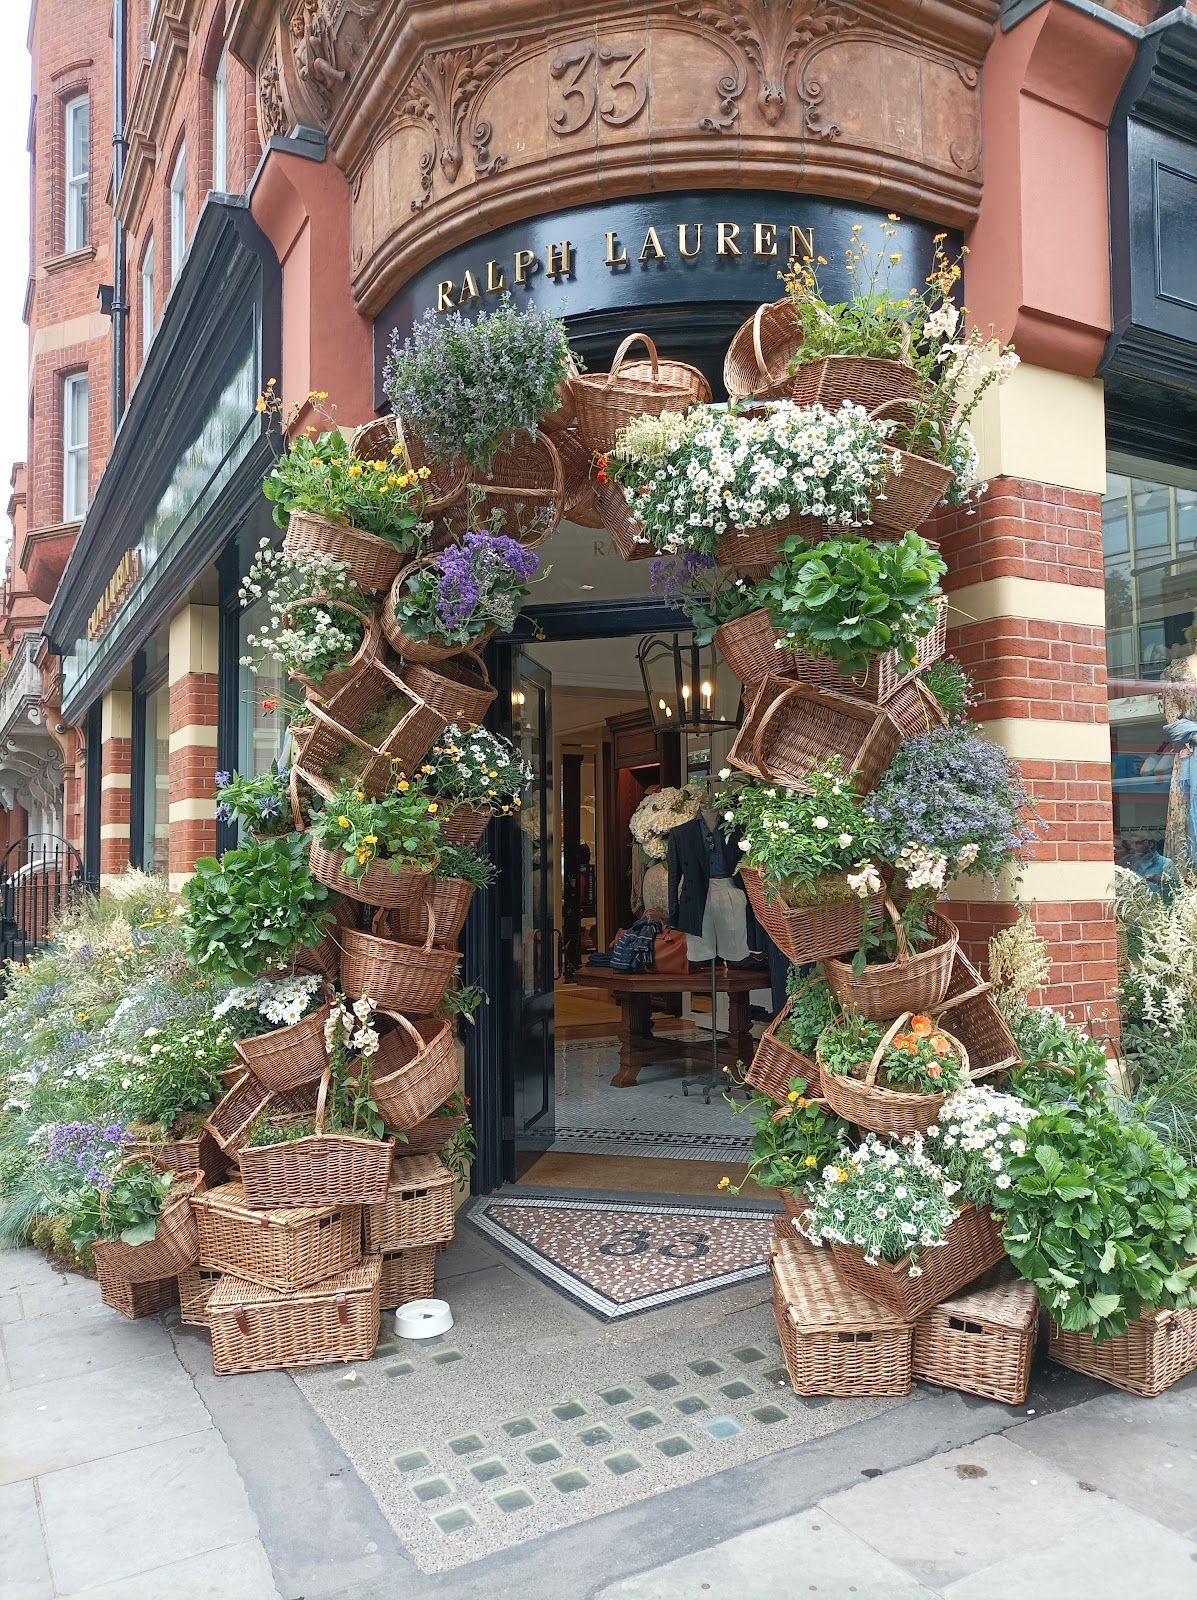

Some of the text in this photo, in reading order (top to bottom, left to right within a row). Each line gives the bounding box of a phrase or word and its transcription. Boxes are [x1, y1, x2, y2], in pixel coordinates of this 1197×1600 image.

[550, 43, 647, 135] 33
[436, 221, 815, 313] RALPH LAUREN
[599, 1229, 711, 1259] 33
